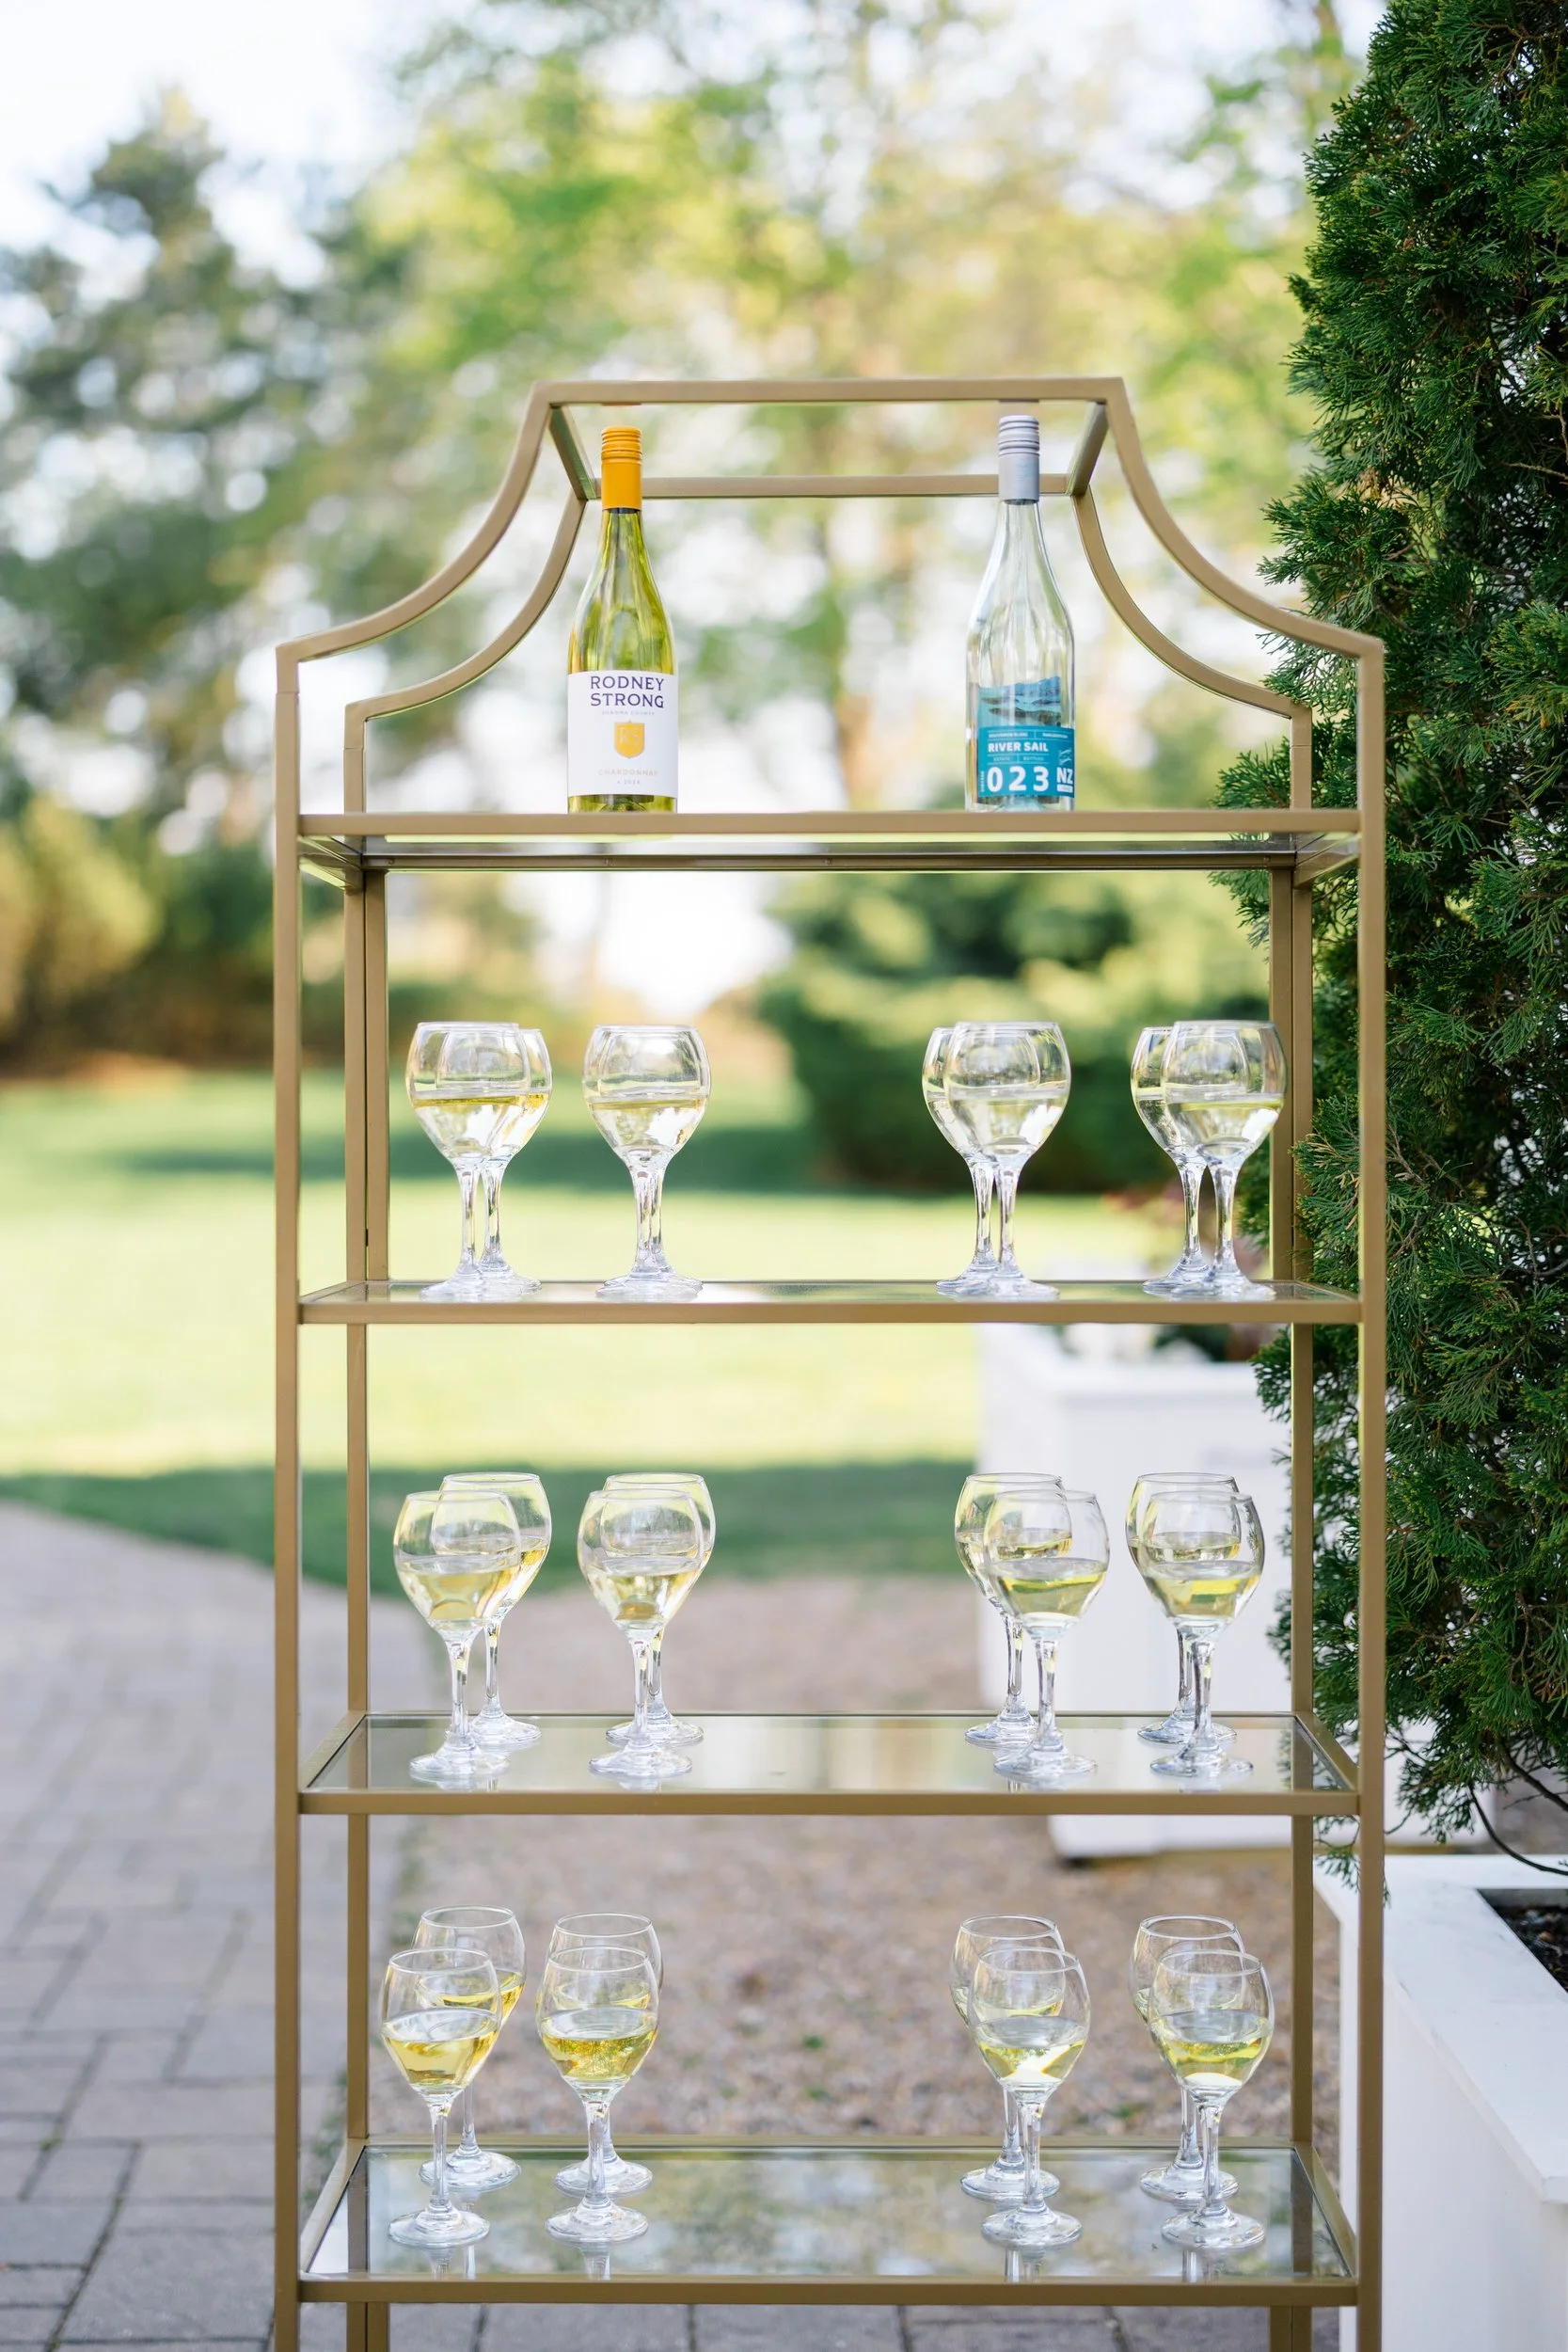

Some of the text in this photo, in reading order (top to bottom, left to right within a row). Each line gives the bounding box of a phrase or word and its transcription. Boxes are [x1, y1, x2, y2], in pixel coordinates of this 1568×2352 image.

[591, 675, 665, 691] RODNEY
[591, 692, 664, 708] STRONG
[988, 741, 1049, 753] RIVER SAIL
[598, 769, 658, 777] CHARDONNAY
[1056, 766, 1073, 785] NZ
